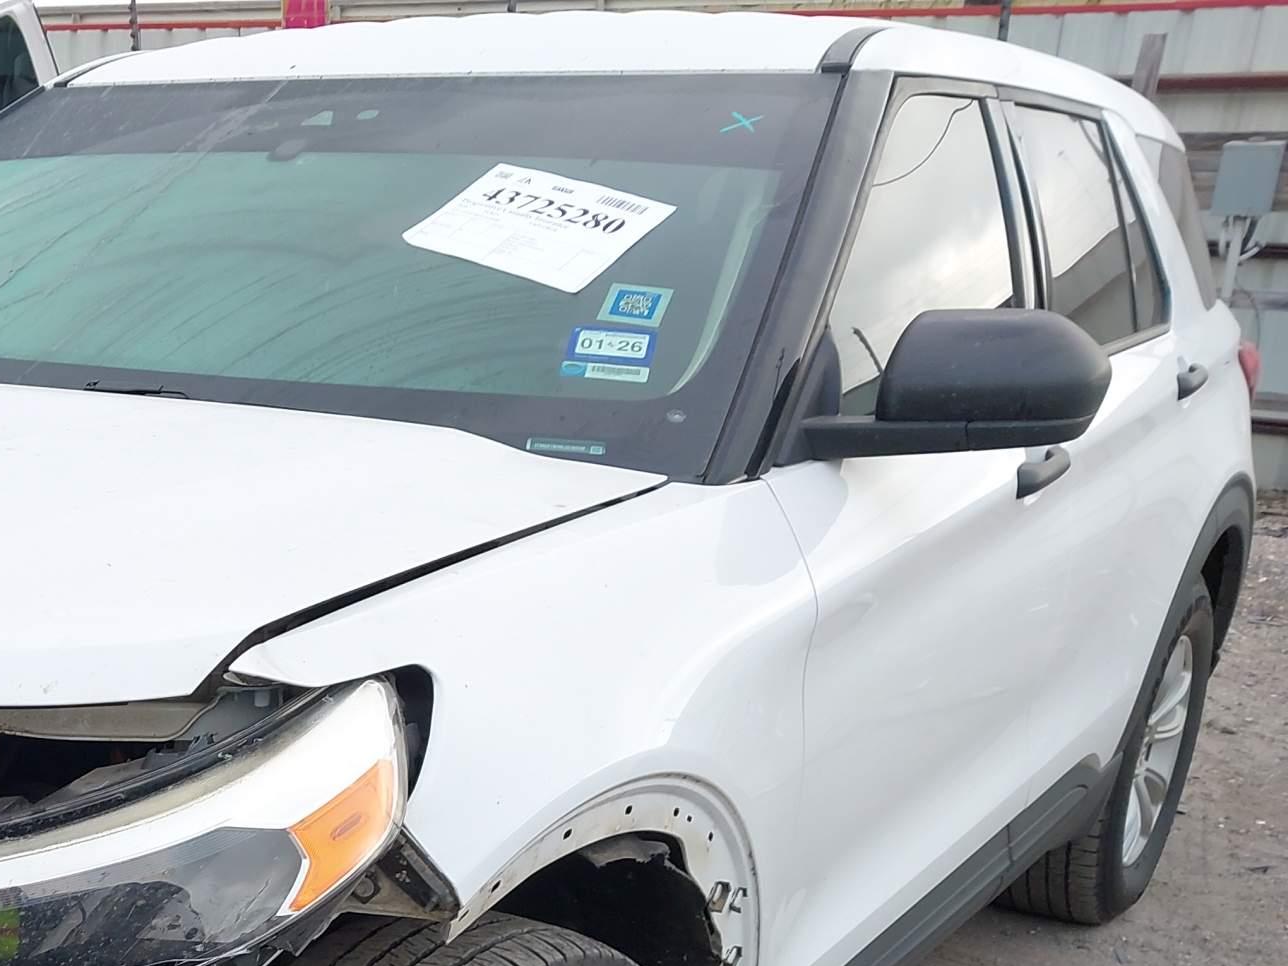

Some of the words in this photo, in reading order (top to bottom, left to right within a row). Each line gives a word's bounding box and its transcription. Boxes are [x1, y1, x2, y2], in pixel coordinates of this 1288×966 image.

[481, 185, 627, 236] 43725280
[580, 336, 605, 351] 01
[615, 339, 644, 354] 26
